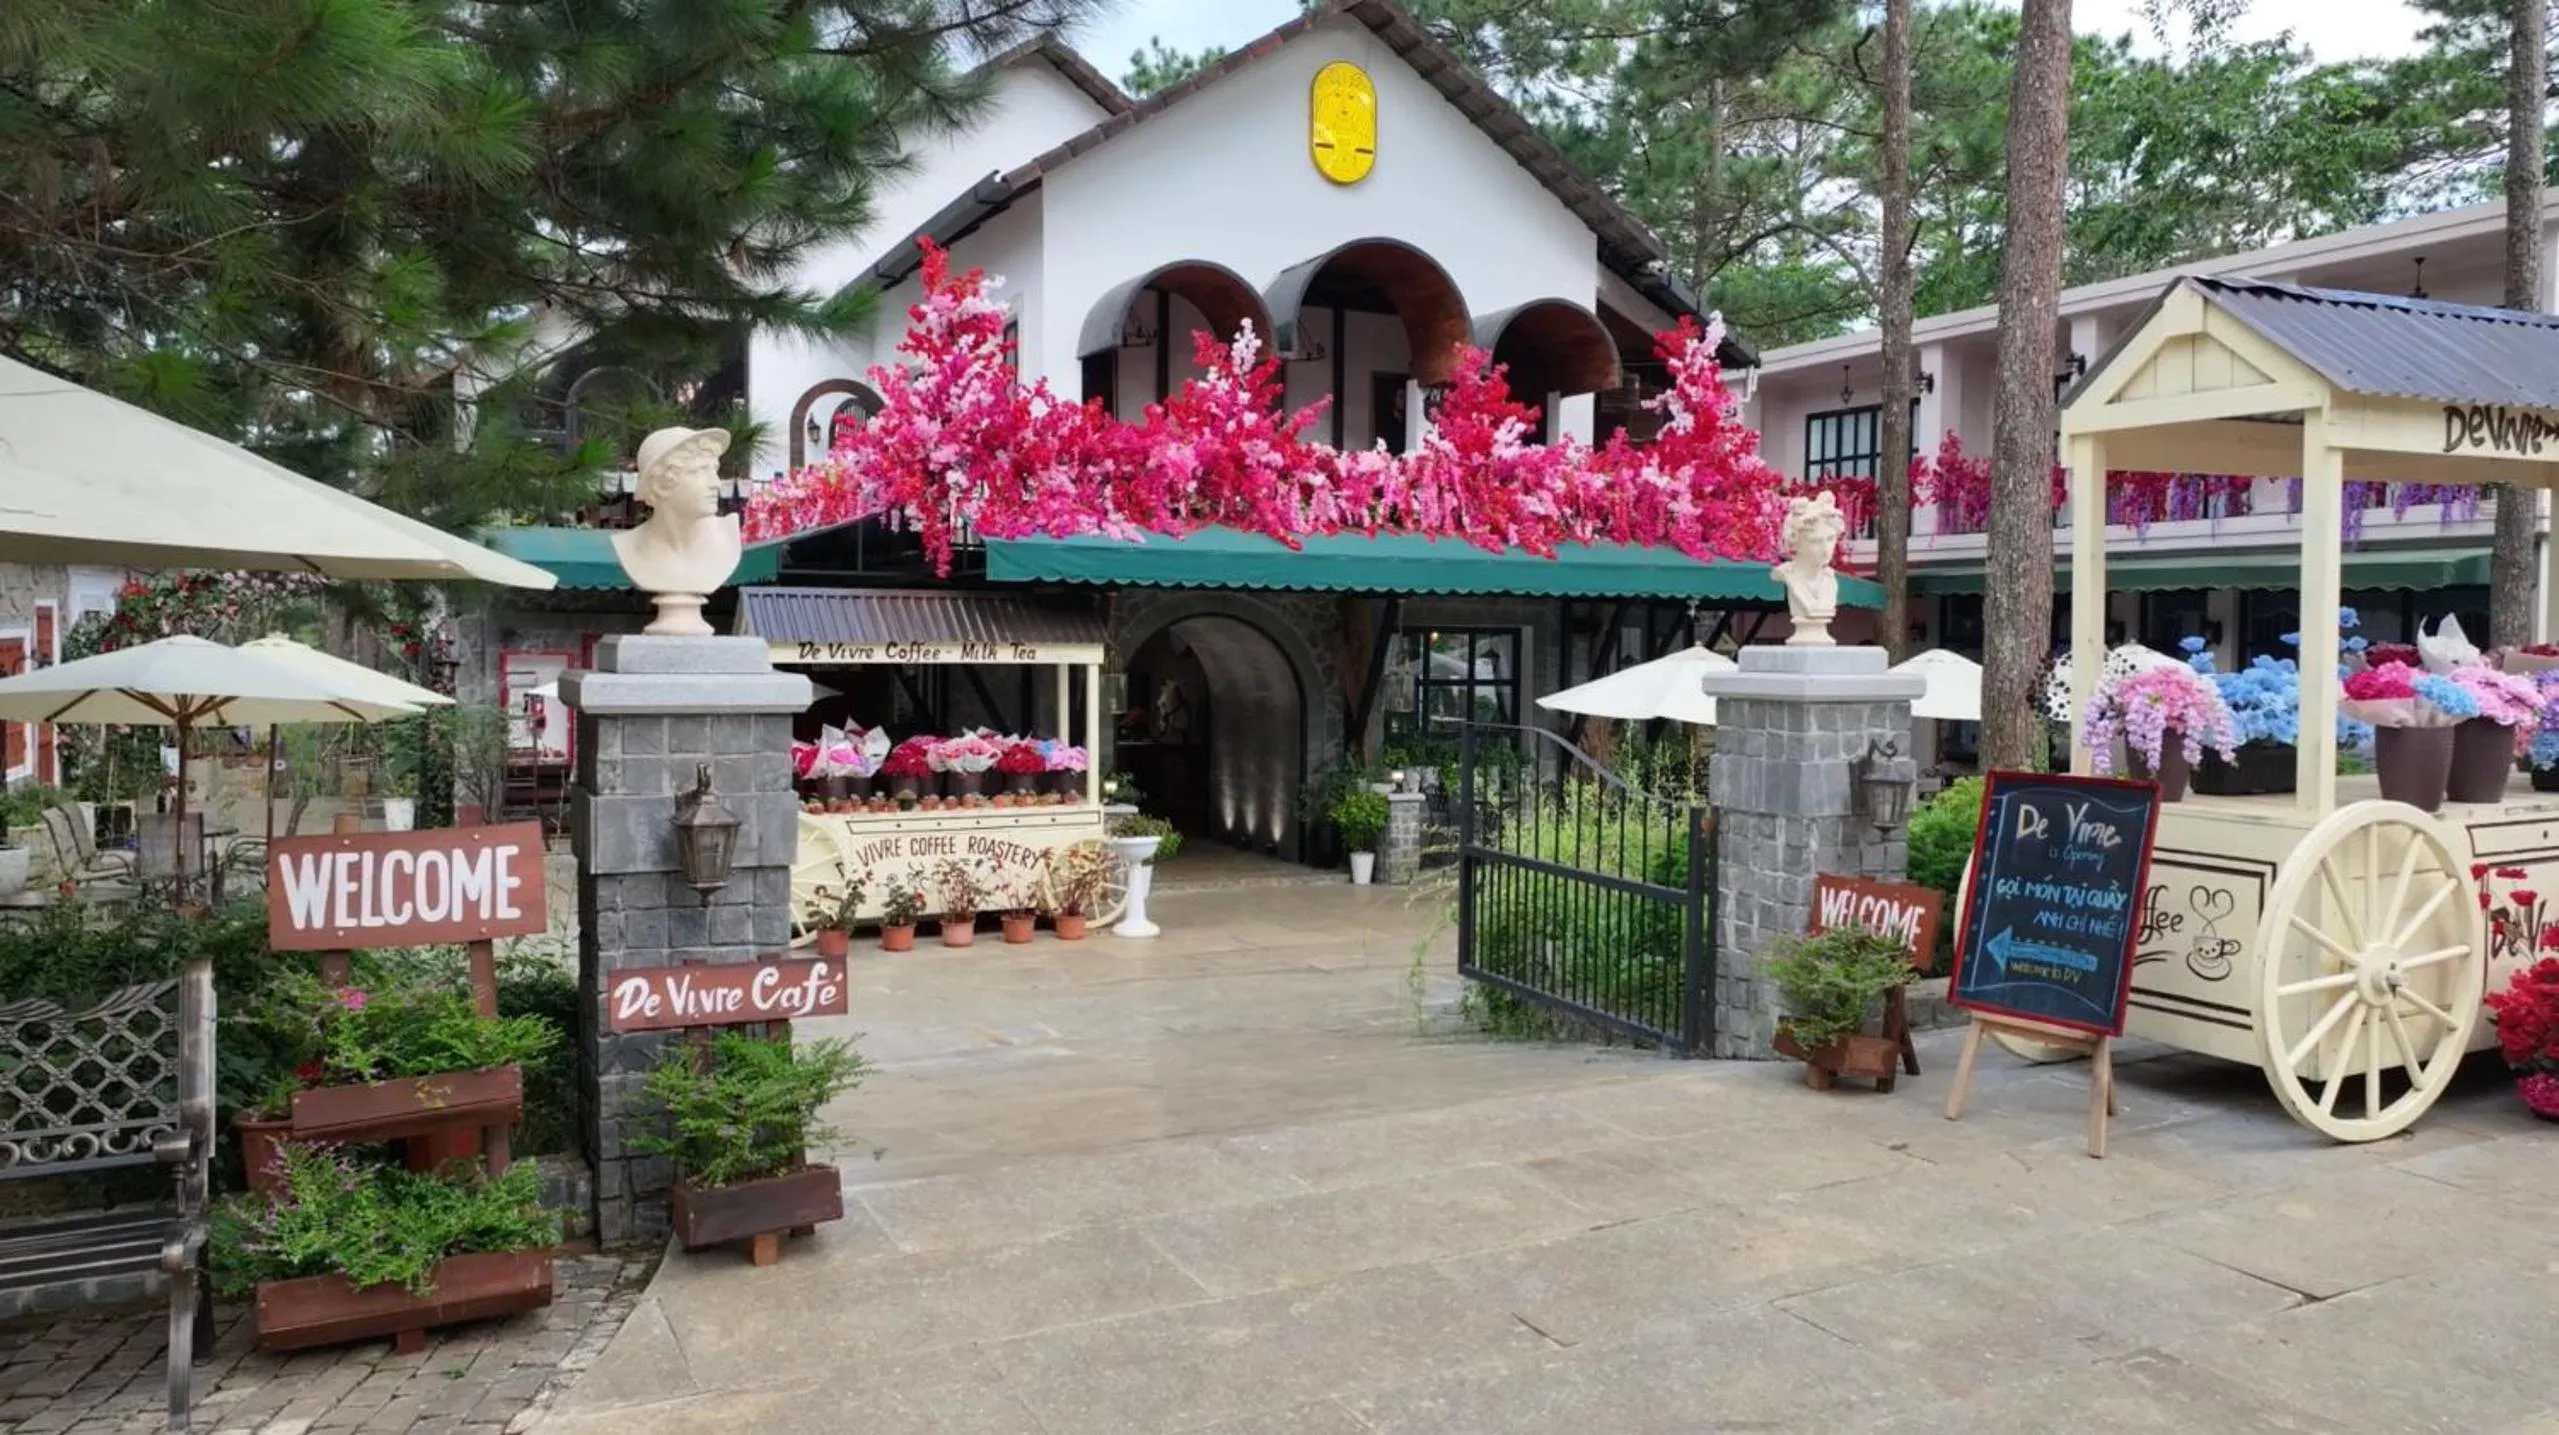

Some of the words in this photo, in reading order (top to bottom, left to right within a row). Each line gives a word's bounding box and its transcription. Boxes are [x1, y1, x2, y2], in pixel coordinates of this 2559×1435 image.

[797, 642, 820, 660] De
[828, 642, 875, 660] Vivre
[885, 641, 941, 663] Coffee
[959, 642, 998, 660] Milk
[1010, 642, 1037, 660] Tea
[2016, 803, 2049, 840] De
[856, 837, 901, 868] VIVRE
[910, 835, 956, 857] COFFEE
[968, 835, 1041, 870] ROASTERY
[278, 844, 522, 930] WELCOME
[2138, 884, 2185, 946] ffee
[613, 976, 662, 1020] De
[666, 973, 744, 1018] Vivre
[751, 962, 844, 1016] Café
